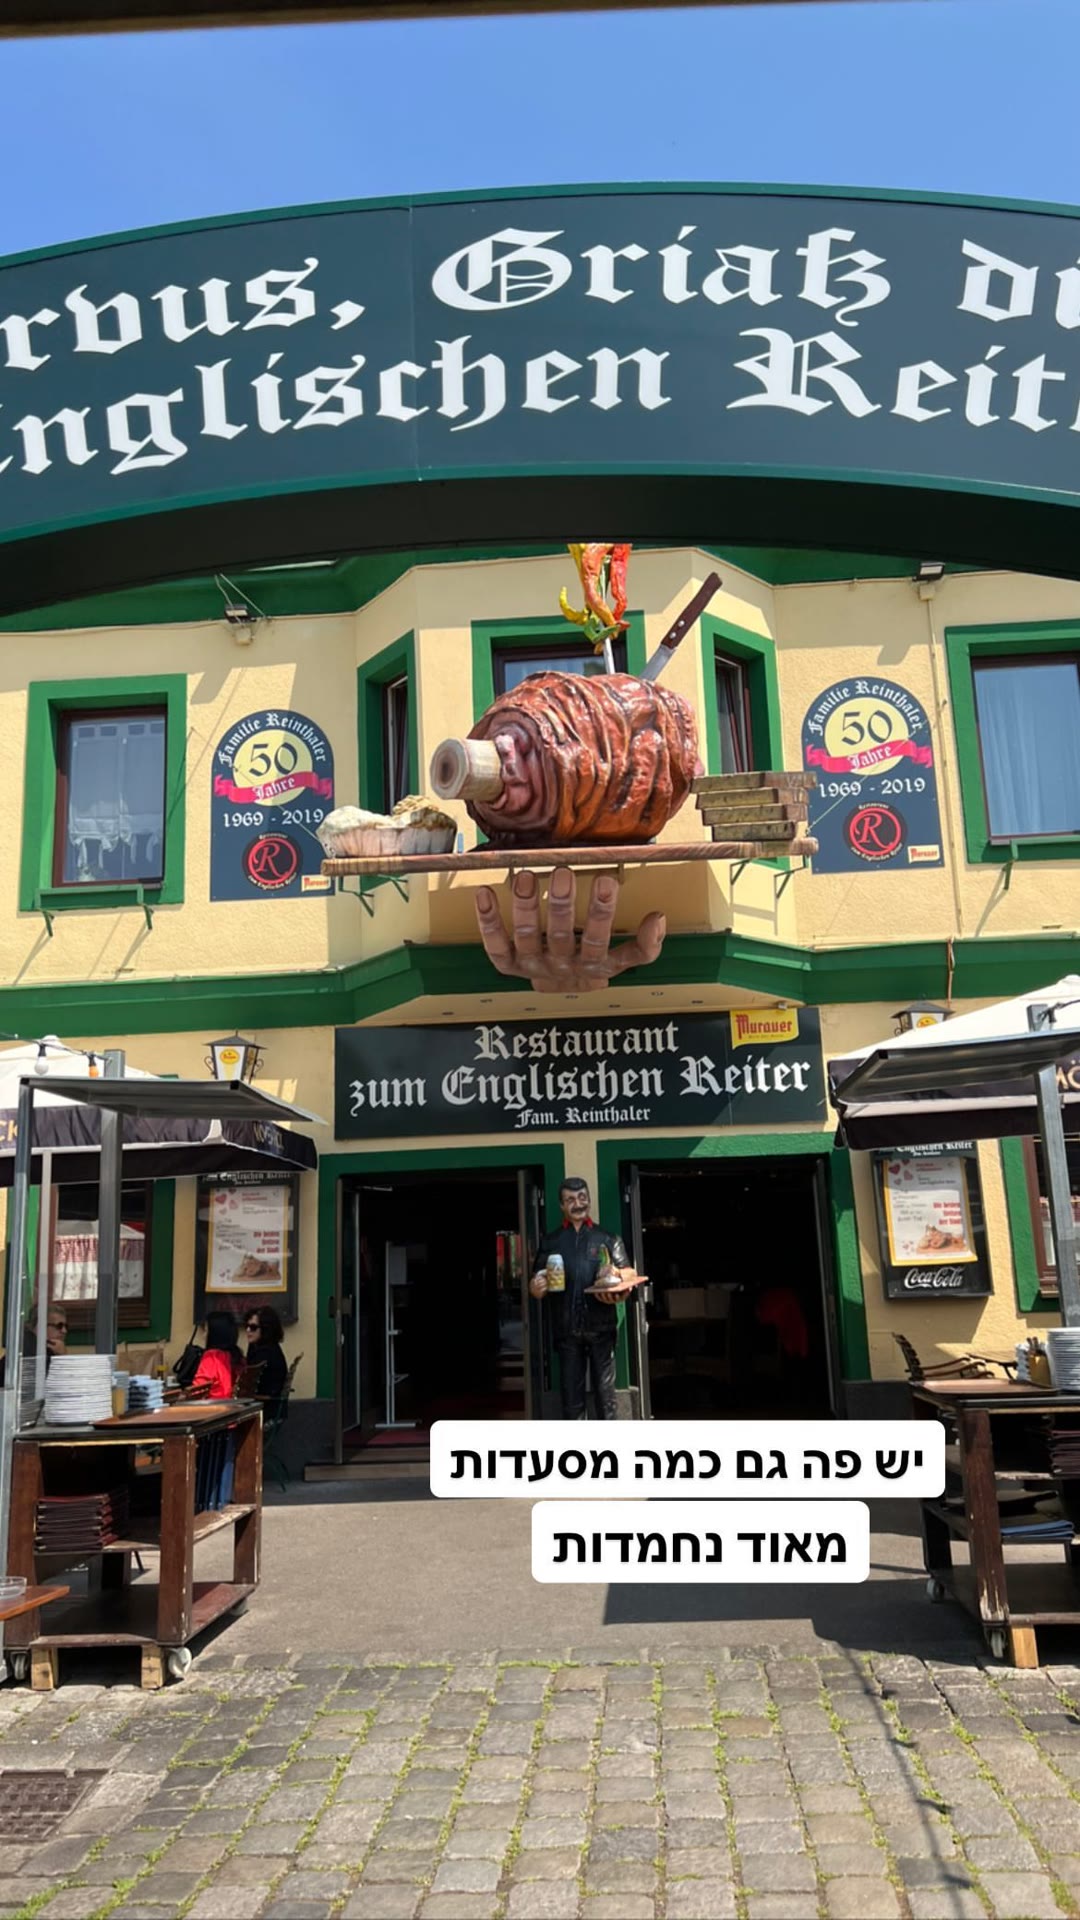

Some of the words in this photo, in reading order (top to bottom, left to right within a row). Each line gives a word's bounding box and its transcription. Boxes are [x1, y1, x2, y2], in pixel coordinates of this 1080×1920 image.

[0, 335, 672, 476] nglischen
[726, 327, 1080, 433] Reit
[809, 687, 850, 737] Familie
[855, 680, 923, 732] Reinthaler
[218, 717, 261, 767] Familie
[266, 712, 327, 763] Reinthaler
[842, 709, 893, 745] 50
[249, 742, 298, 777] 50
[847, 744, 892, 772] Jahre
[252, 777, 296, 801] Jahre
[819, 780, 862, 798] 1969
[881, 777, 926, 795] 2019
[223, 811, 264, 827] 1969
[282, 808, 324, 825] 2019
[473, 1020, 680, 1061] Restaurant
[735, 1013, 793, 1040] Murauer
[349, 1074, 427, 1117] zum
[441, 1060, 665, 1110] Englischen
[679, 1054, 812, 1096] Reiter
[515, 1108, 559, 1129] Fam.
[565, 1105, 651, 1125] Reinthaler
